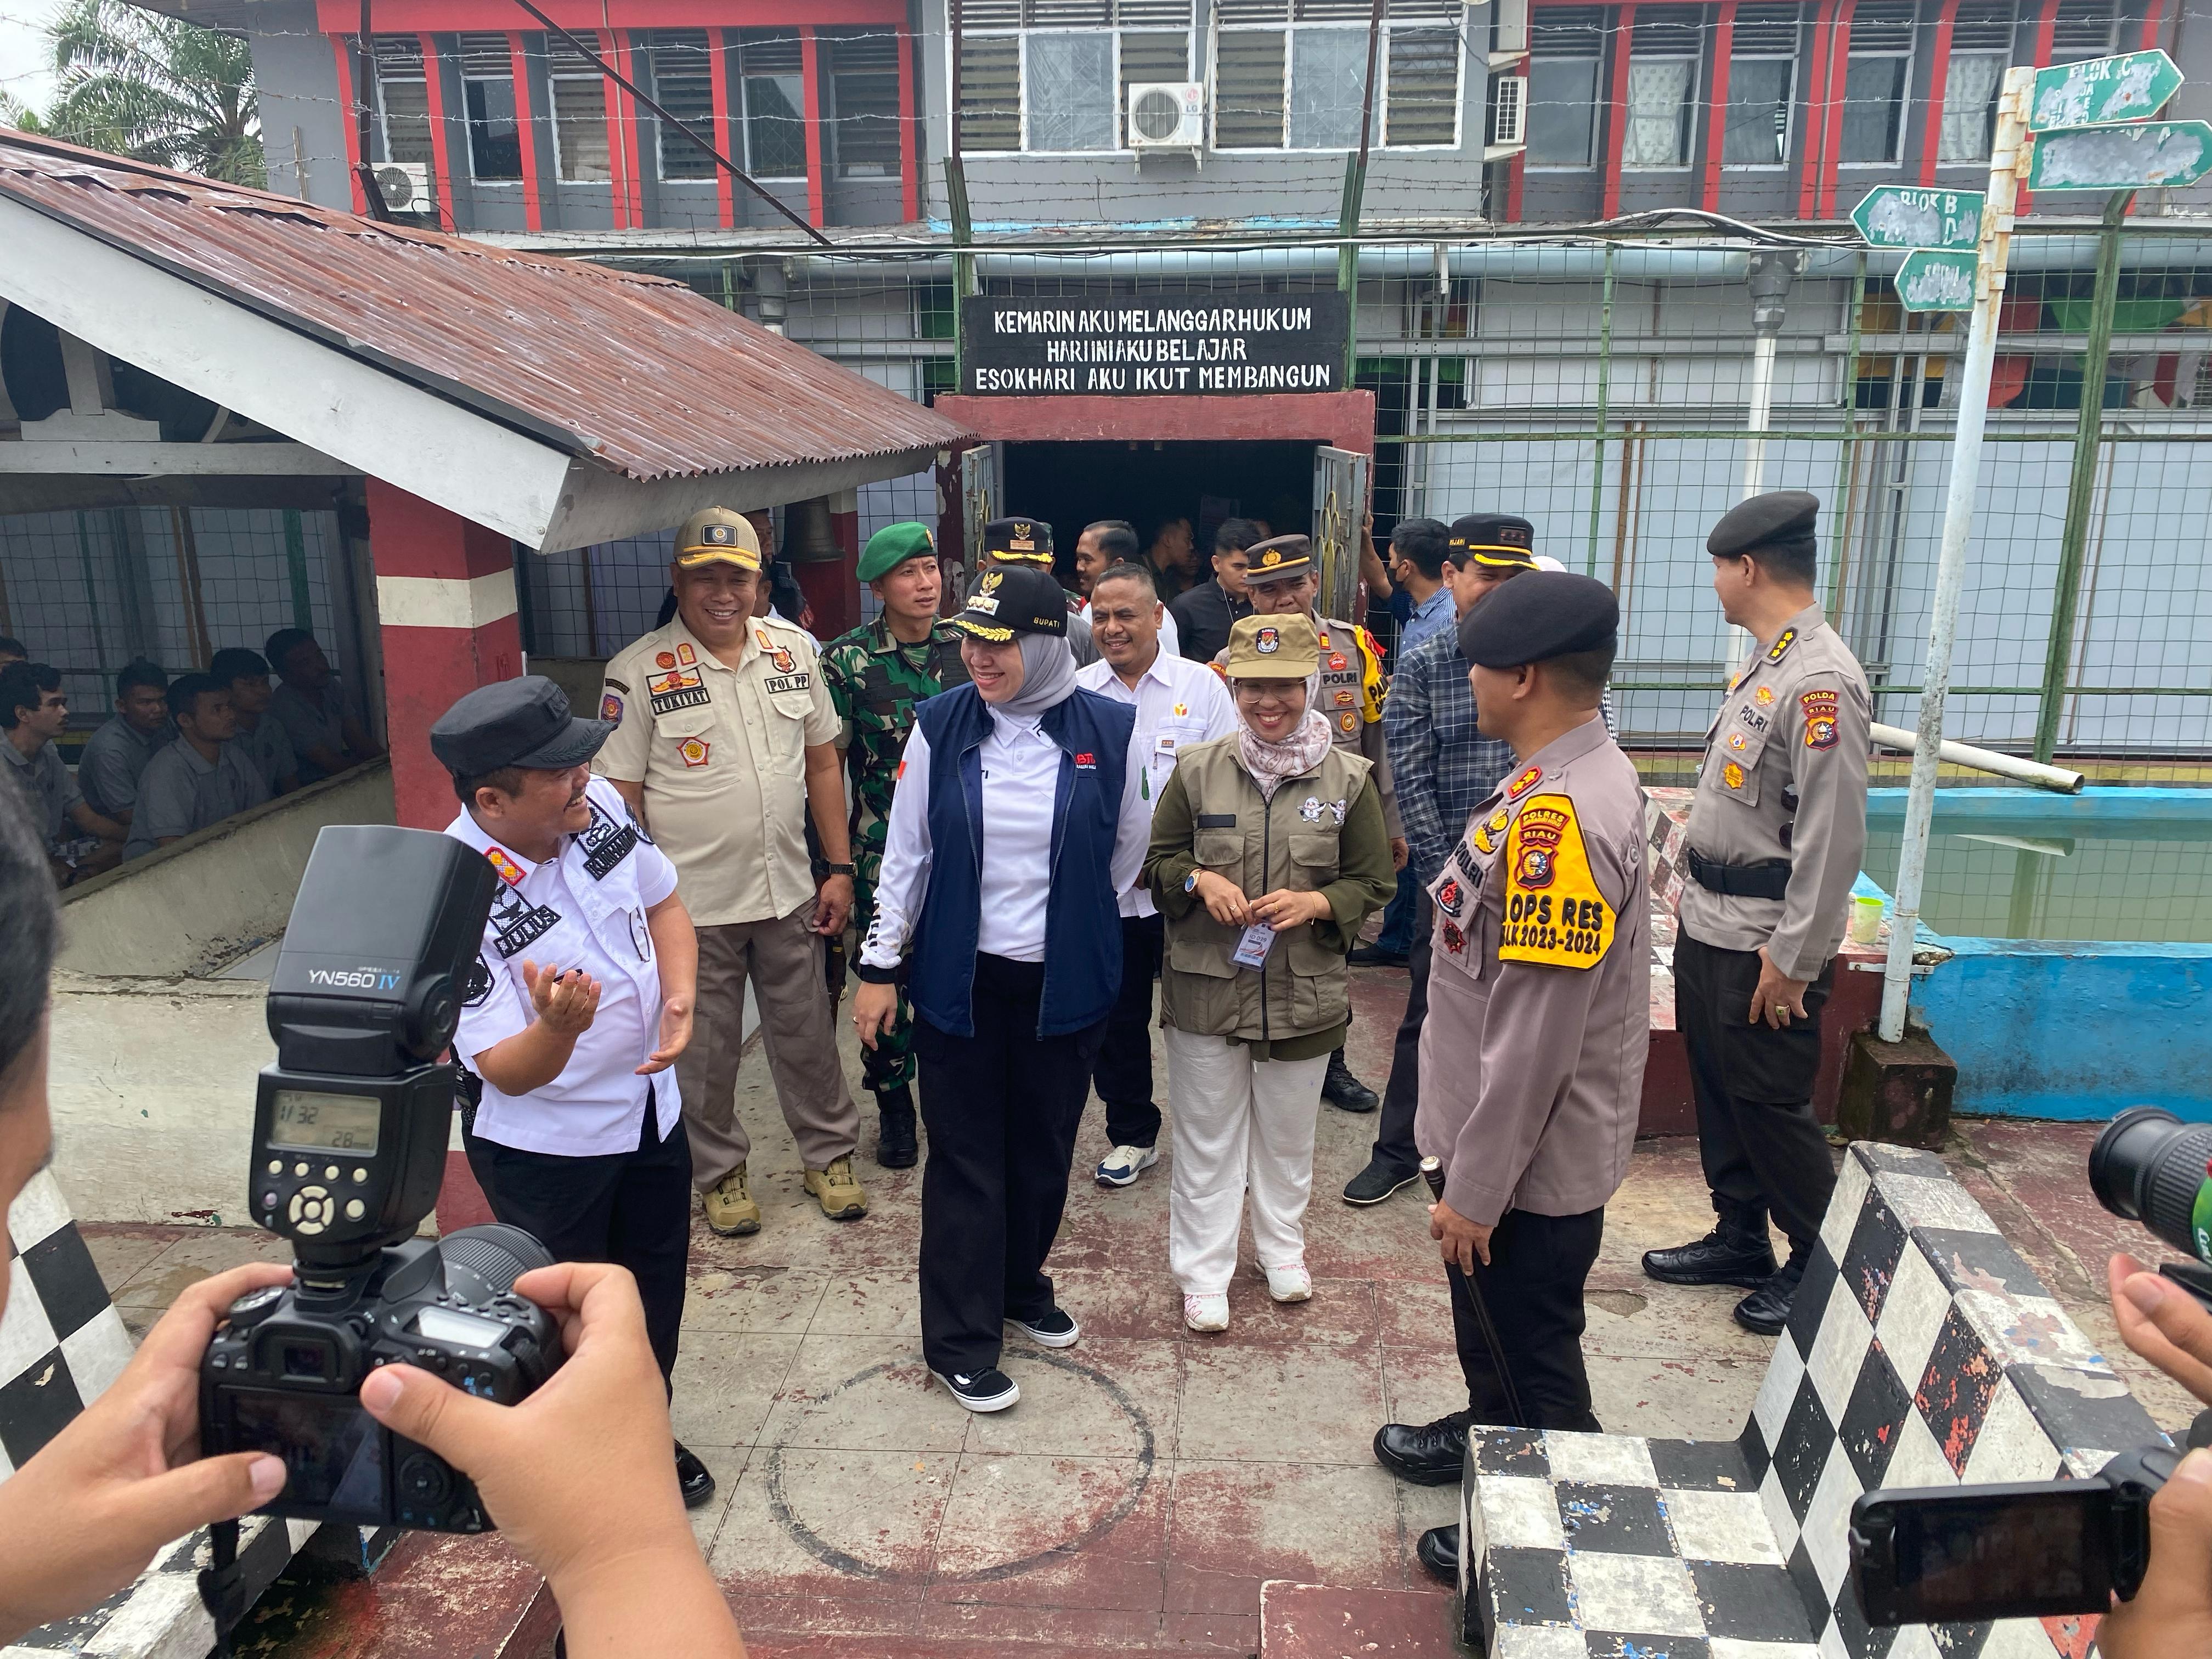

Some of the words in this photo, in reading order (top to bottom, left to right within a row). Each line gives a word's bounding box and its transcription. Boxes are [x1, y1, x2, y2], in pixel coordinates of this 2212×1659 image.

[1945, 194, 1958, 213] B
[995, 310, 1075, 333] KEMARIN
[1078, 310, 1114, 333] AKU
[1156, 337, 1247, 362] BELAJAR
[1087, 368, 1125, 390] AKU
[1136, 366, 1190, 390] IKUT
[1199, 364, 1330, 389] MEMBANGUN
[1033, 617, 1060, 628] BUPATI
[769, 678, 793, 691] POL
[794, 676, 806, 687] PP
[1323, 672, 1357, 685] POLRI
[654, 691, 706, 712] TUKIYAT
[1803, 692, 1835, 704] POLDA
[1739, 704, 1769, 733] POLRI
[1523, 810, 1565, 822] POLRES
[1524, 831, 1556, 840] RIAU
[1454, 840, 1483, 888] POLRI
[1510, 894, 1552, 924] OPS
[1562, 898, 1603, 931] RES
[499, 908, 555, 954] JULIUS
[1519, 924, 1601, 956] 2023-2024
[308, 969, 376, 988] YN560
[377, 974, 401, 990] IV
